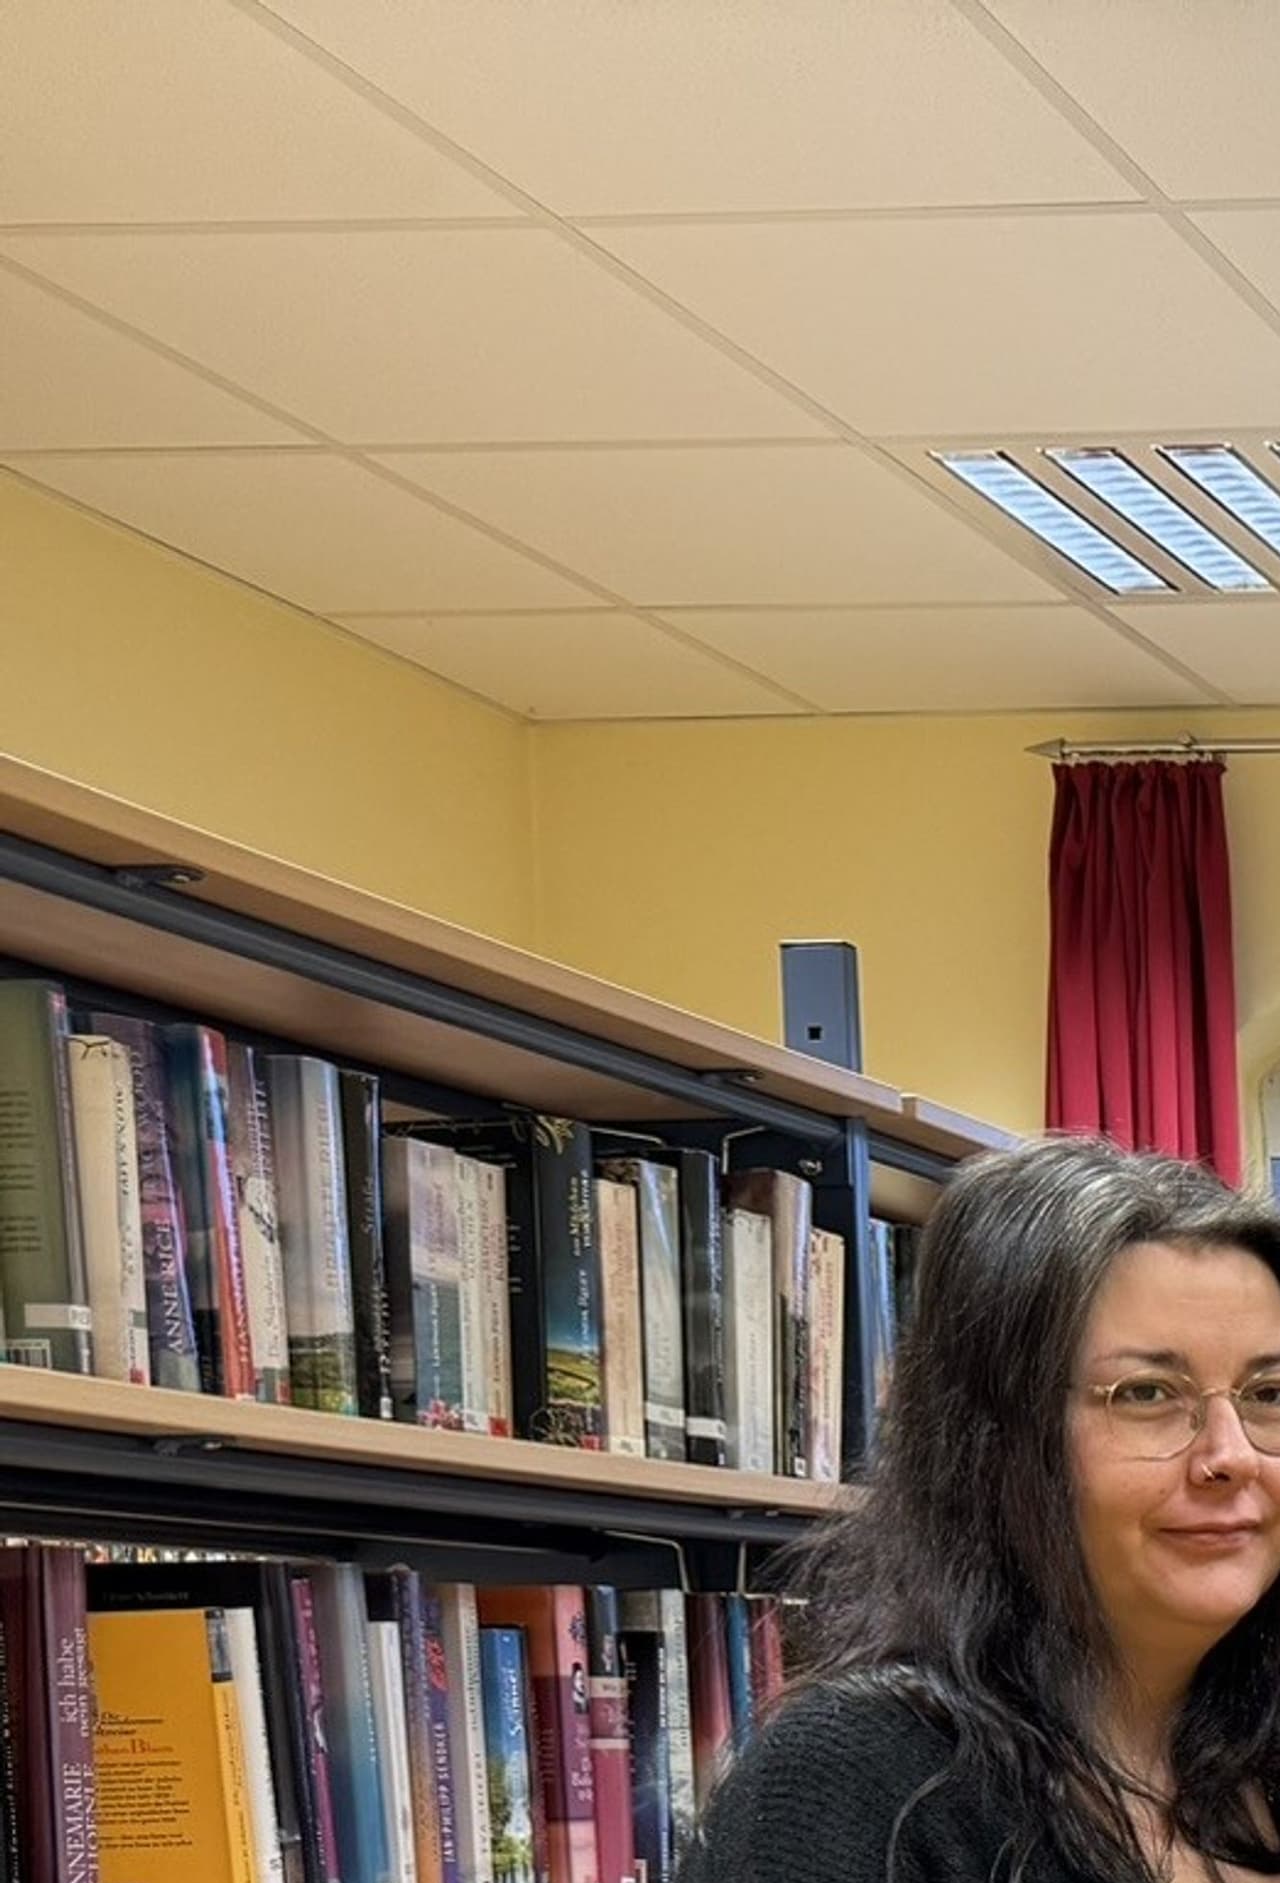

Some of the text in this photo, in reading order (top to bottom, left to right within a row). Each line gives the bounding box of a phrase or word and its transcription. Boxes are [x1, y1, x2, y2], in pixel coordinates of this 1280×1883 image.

[153, 1218, 185, 1355] ANNE RICE
[55, 1637, 78, 1725] ich habe
[433, 1721, 452, 1780] SENDKER
